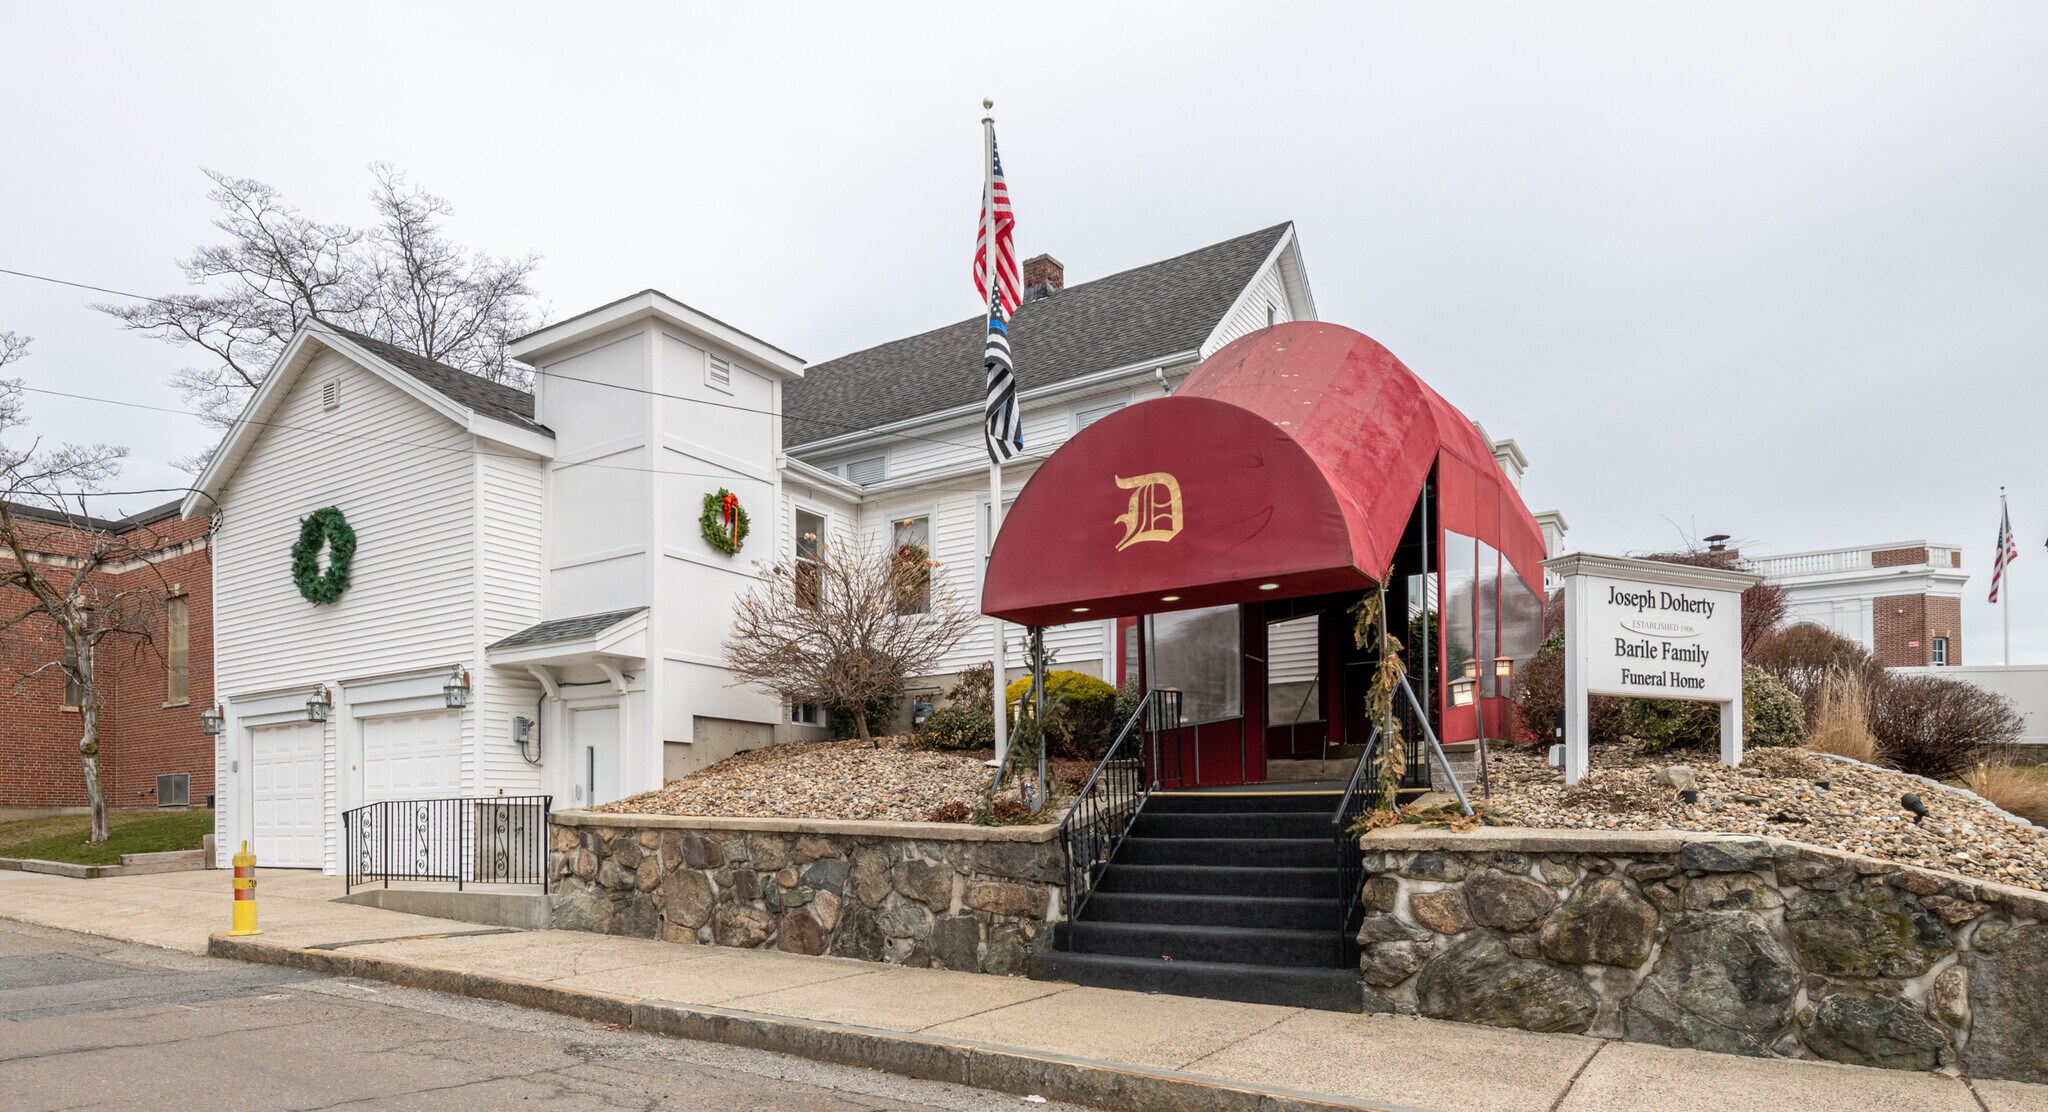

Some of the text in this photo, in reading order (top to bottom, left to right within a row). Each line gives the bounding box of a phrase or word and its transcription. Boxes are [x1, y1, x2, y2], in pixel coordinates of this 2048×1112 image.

[1114, 472, 1184, 552] D
[1608, 586, 1715, 619] Joseph Doherty
[1632, 620, 1695, 633] ESTABLISHED 1906
[1614, 637, 1709, 668] Barile Family
[1621, 668, 1705, 689] Funeral Home
